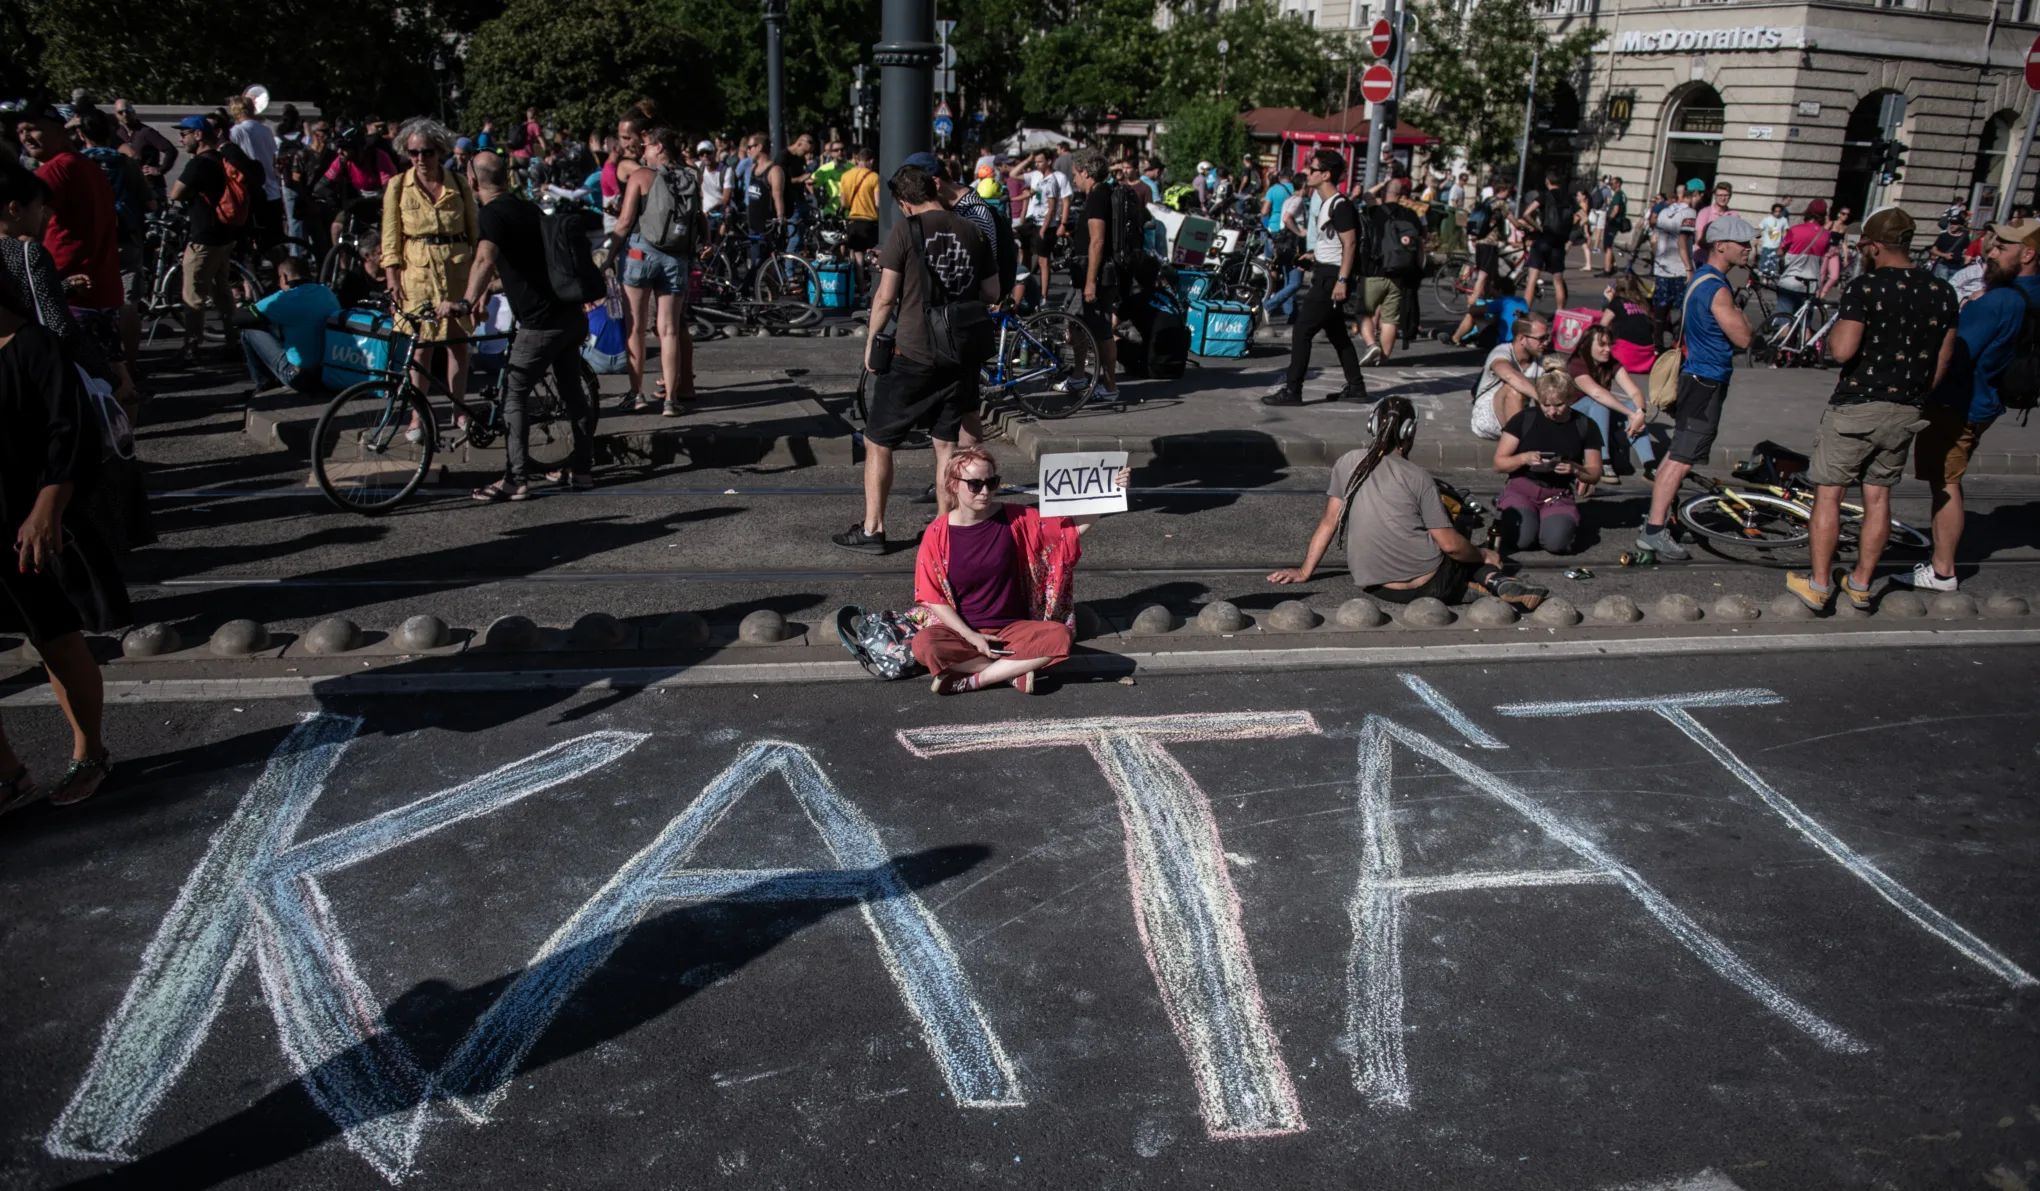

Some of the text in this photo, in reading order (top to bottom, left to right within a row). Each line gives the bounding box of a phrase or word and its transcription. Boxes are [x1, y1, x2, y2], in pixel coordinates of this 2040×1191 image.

[1622, 26, 1783, 51] McDonald's
[1214, 320, 1244, 334] Wolt
[331, 345, 376, 368] Wolt
[45, 672, 2039, 1184] KATÁT
